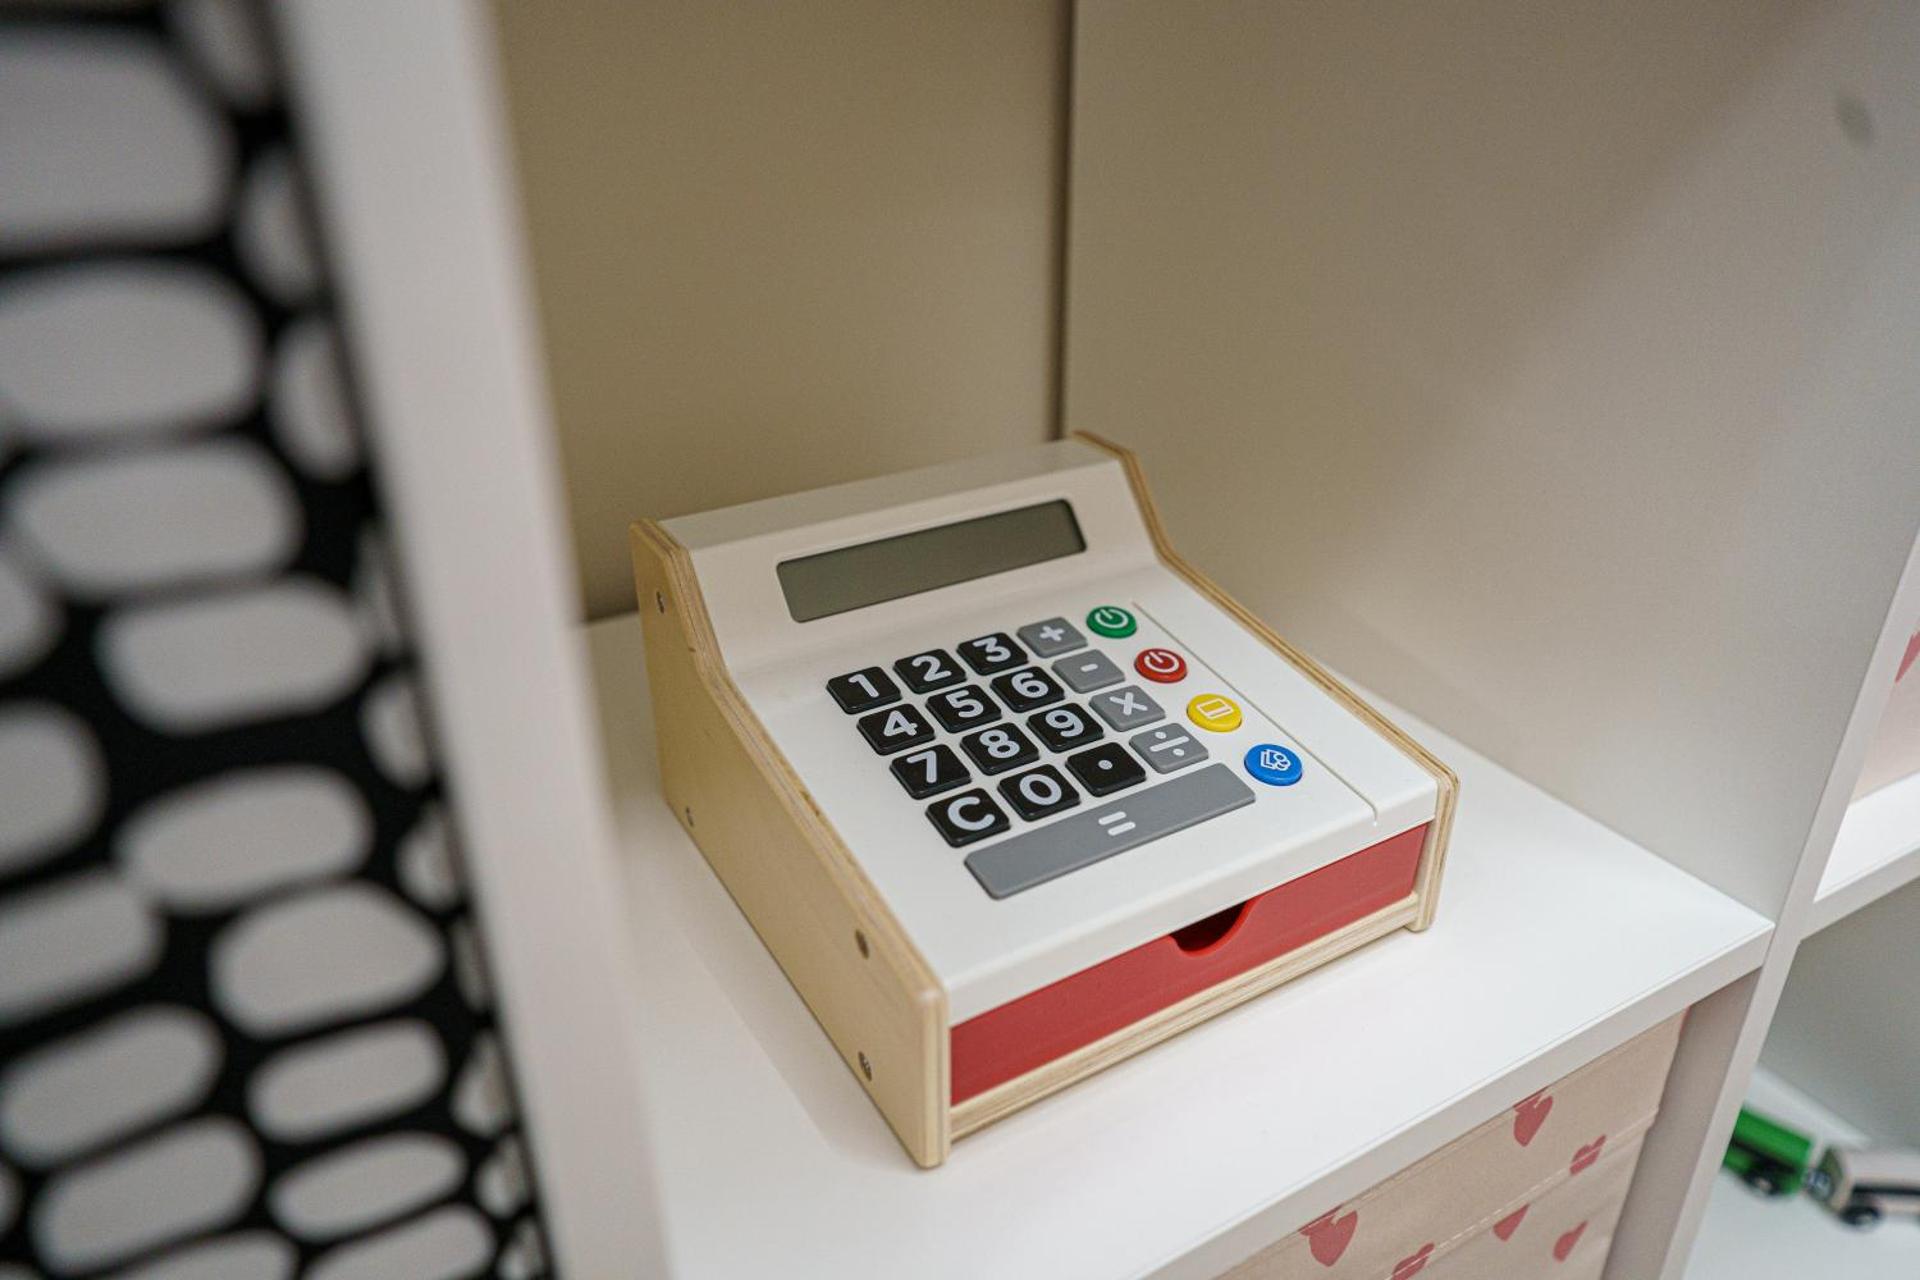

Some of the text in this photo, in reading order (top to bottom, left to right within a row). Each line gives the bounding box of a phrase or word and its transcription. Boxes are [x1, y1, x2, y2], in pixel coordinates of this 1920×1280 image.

[848, 673, 879, 698] 1
[911, 655, 952, 682] 2
[972, 637, 1011, 662] 3
[883, 710, 918, 737] 4
[945, 689, 984, 718] 5
[1011, 672, 1049, 698] 6
[906, 750, 937, 784] 7
[979, 729, 1020, 759] 8
[1045, 709, 1084, 737] 9
[947, 796, 996, 831] C
[1019, 773, 1062, 806] 0
